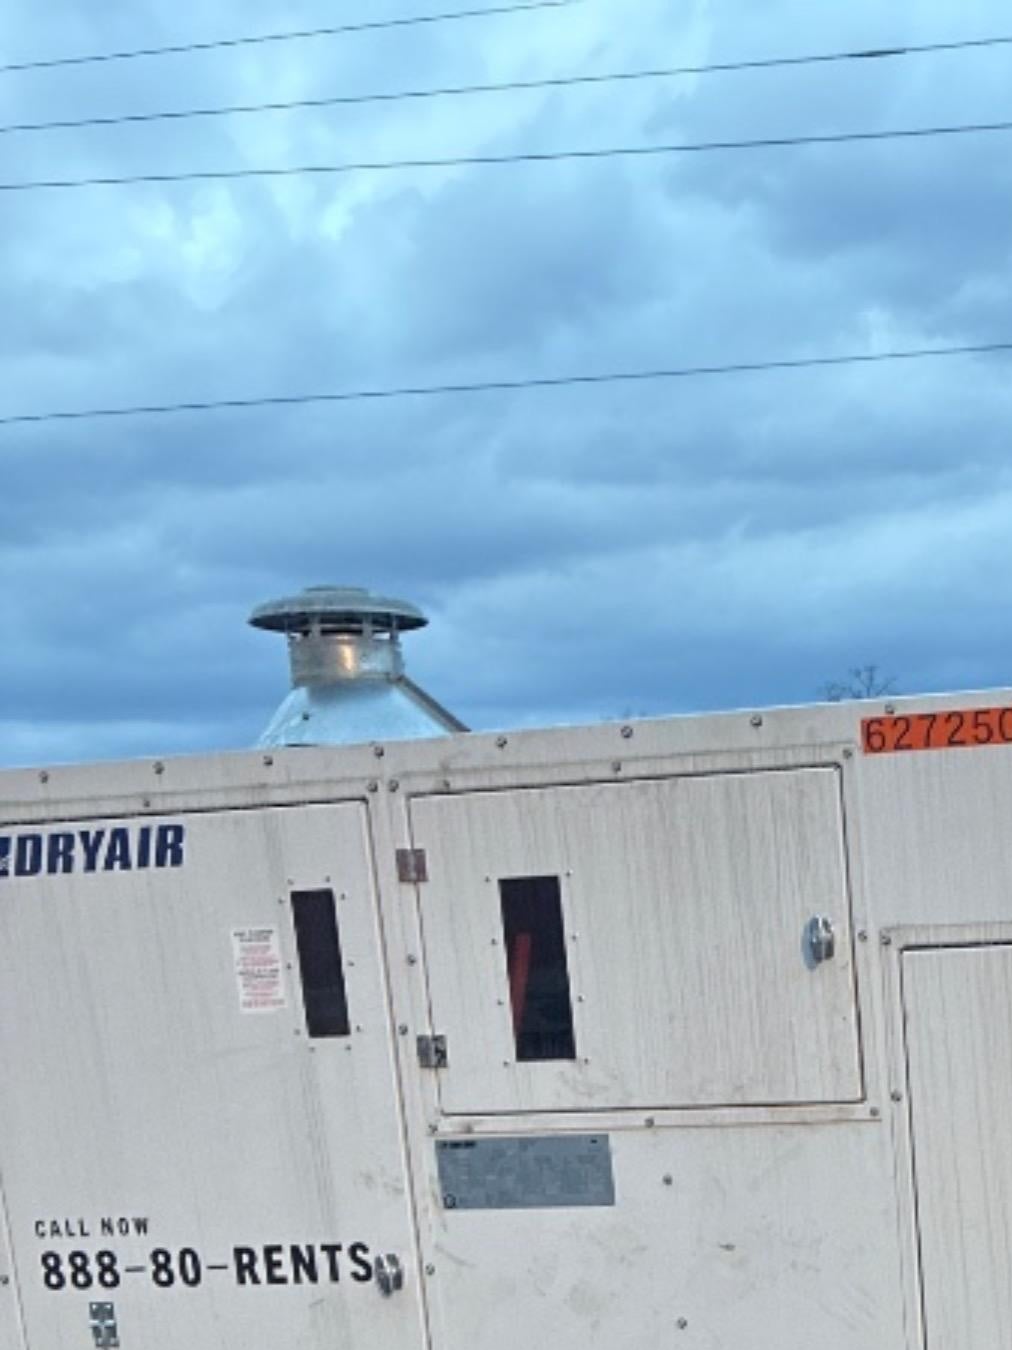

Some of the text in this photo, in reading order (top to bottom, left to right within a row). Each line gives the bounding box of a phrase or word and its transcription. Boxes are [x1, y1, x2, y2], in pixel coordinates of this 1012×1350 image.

[35, 1216, 149, 1239] CALL NOW
[40, 1241, 374, 1291] 888-80-RENTS
